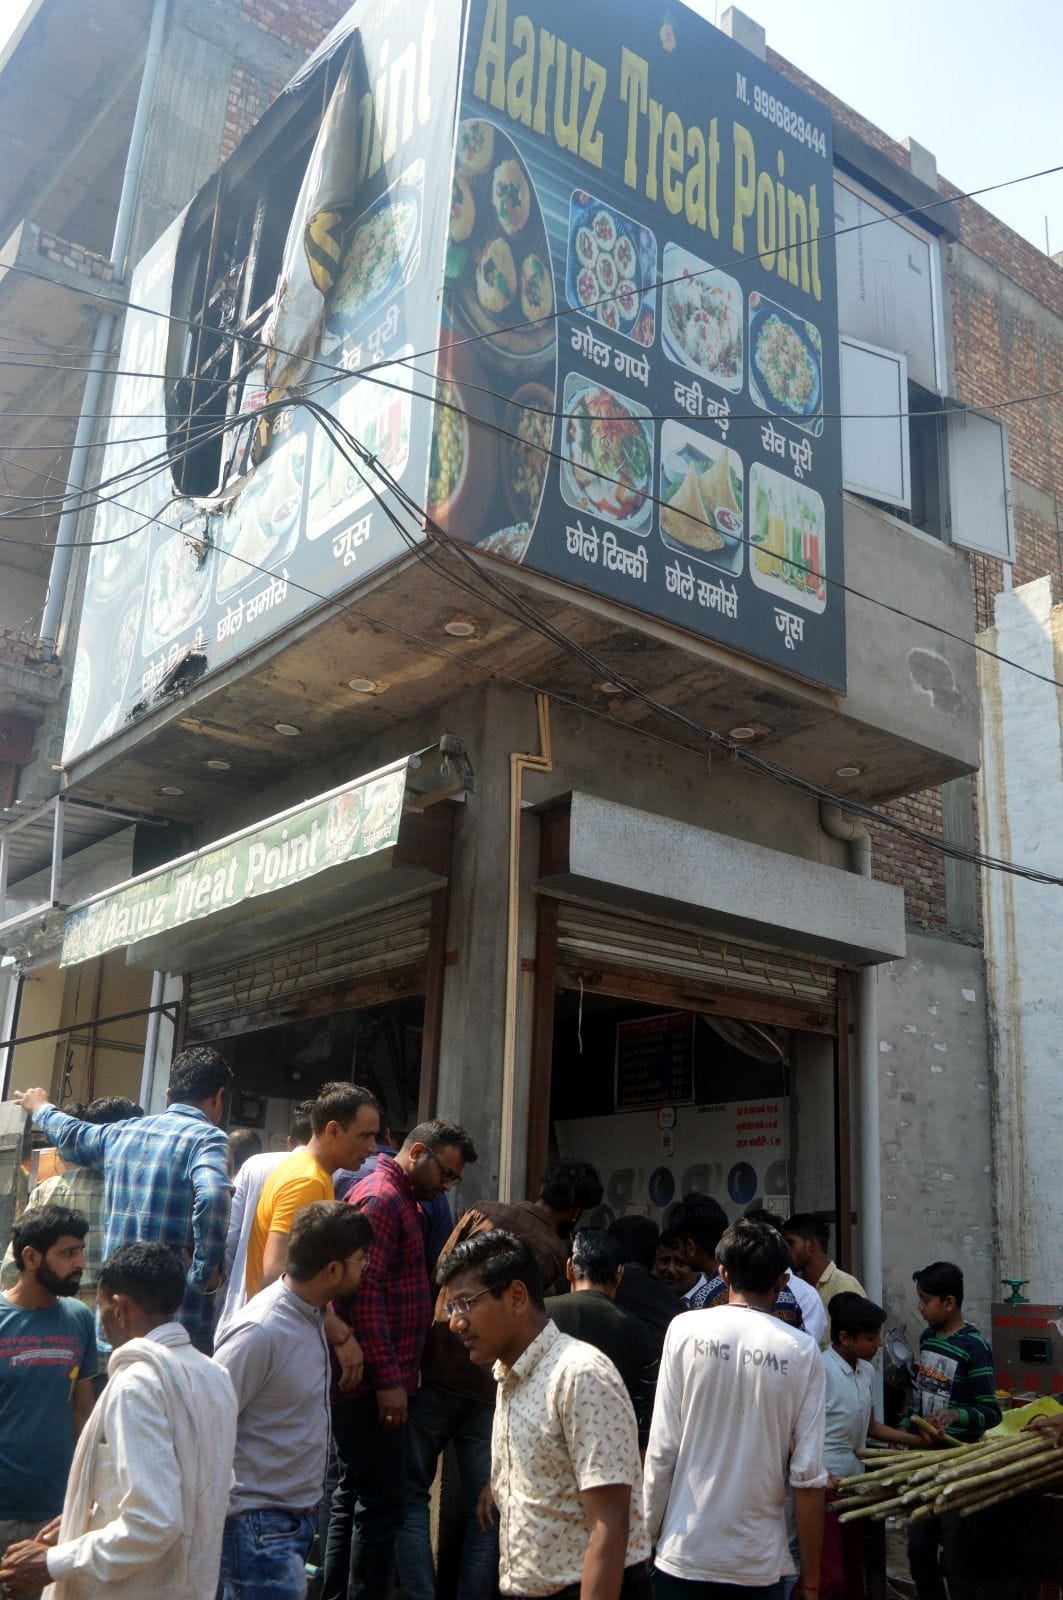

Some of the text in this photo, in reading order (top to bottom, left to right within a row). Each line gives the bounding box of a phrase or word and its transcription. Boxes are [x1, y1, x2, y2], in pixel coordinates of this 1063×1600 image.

[736, 72, 826, 159] M. 9996829444
[474, 0, 823, 302] Aaruz Treat Point
[570, 326, 650, 387] गोल गप्पे
[674, 381, 703, 415] दही
[760, 422, 812, 479] सेव पूरी
[332, 512, 373, 567] जूस
[565, 521, 648, 583] छोले टिक्की
[217, 567, 289, 642] छोले समोसे
[665, 559, 739, 619] छोले समोसे
[774, 608, 804, 650] जूस
[102, 893, 169, 946] Aaruz
[174, 855, 239, 920] Treat
[245, 819, 321, 894] Point
[743, 1349, 789, 1376] DOME
